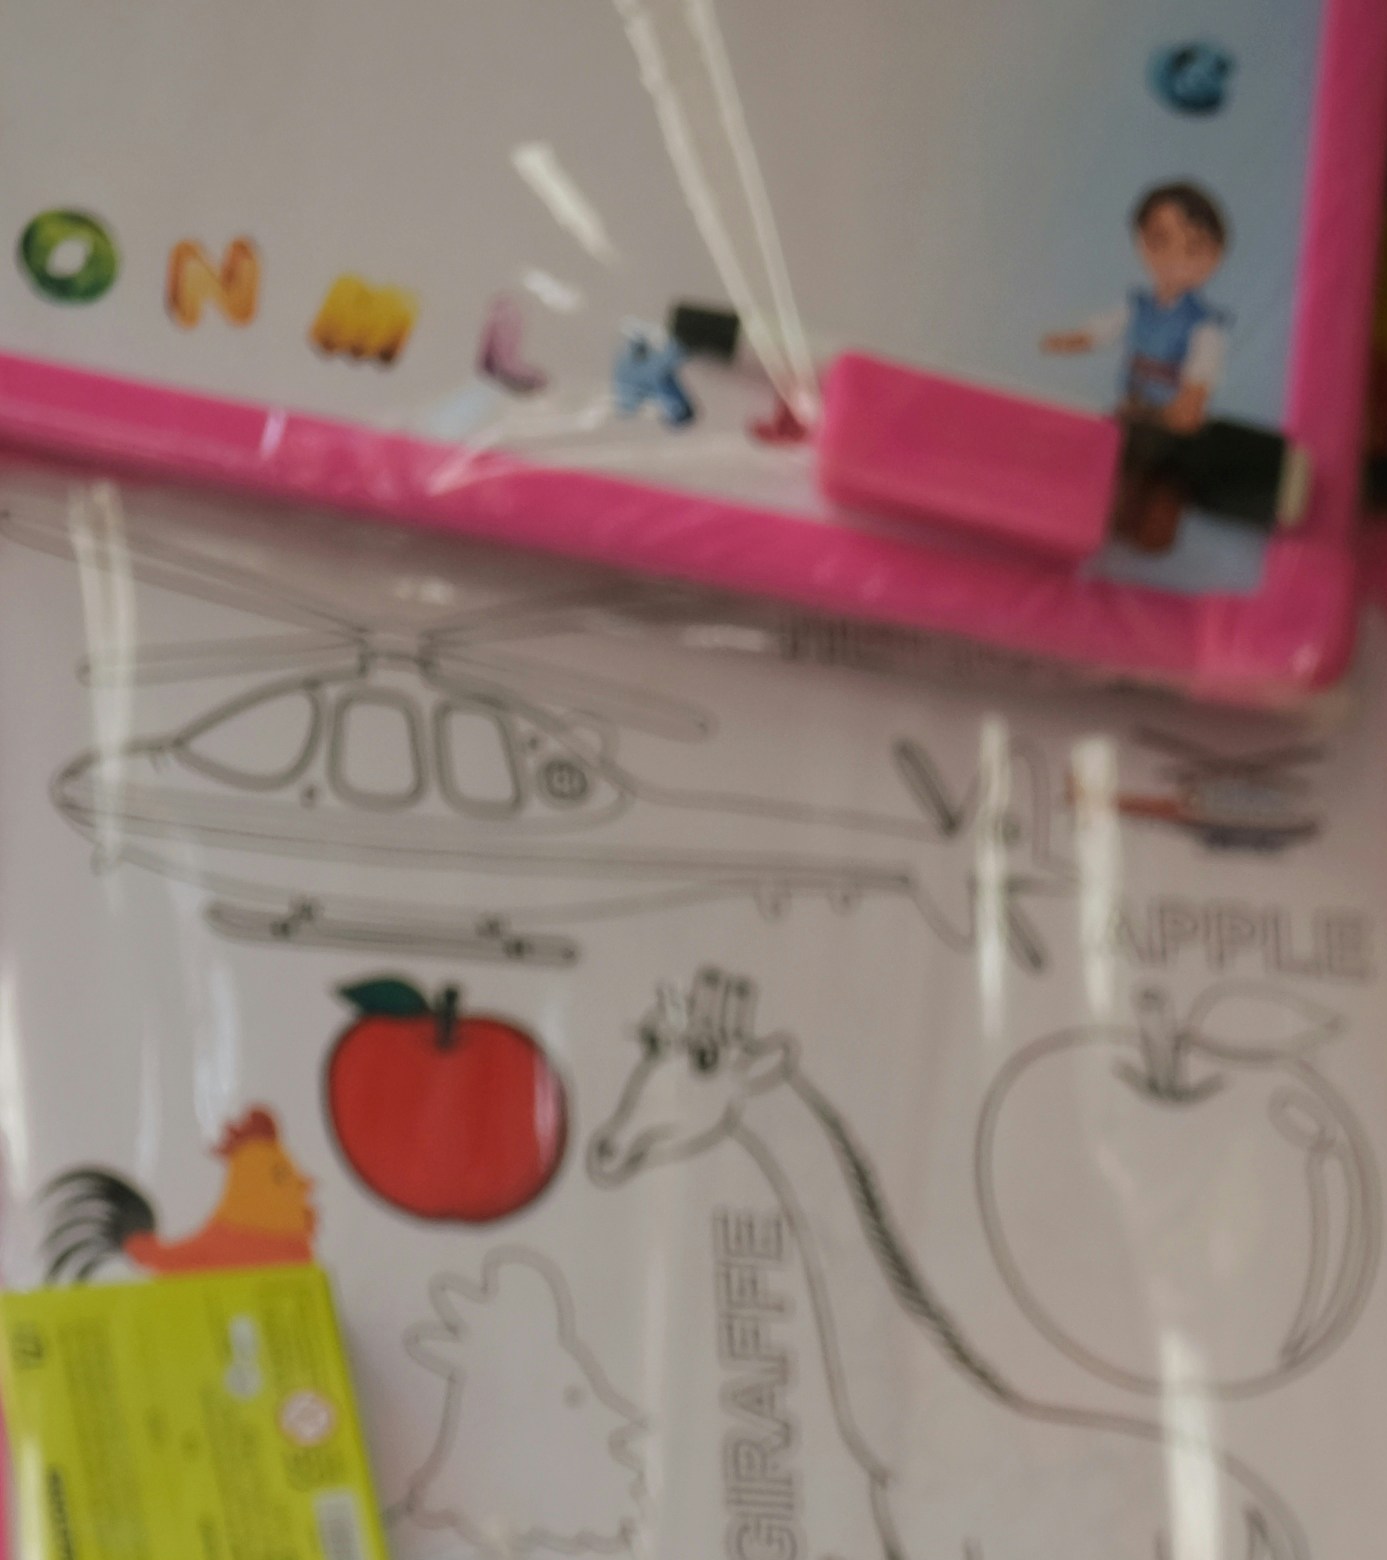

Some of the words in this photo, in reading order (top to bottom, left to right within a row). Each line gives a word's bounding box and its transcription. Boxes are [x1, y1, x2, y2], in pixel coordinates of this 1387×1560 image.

[18, 208, 119, 304] O
[165, 235, 262, 330] N
[1102, 900, 1378, 984] APPLE
